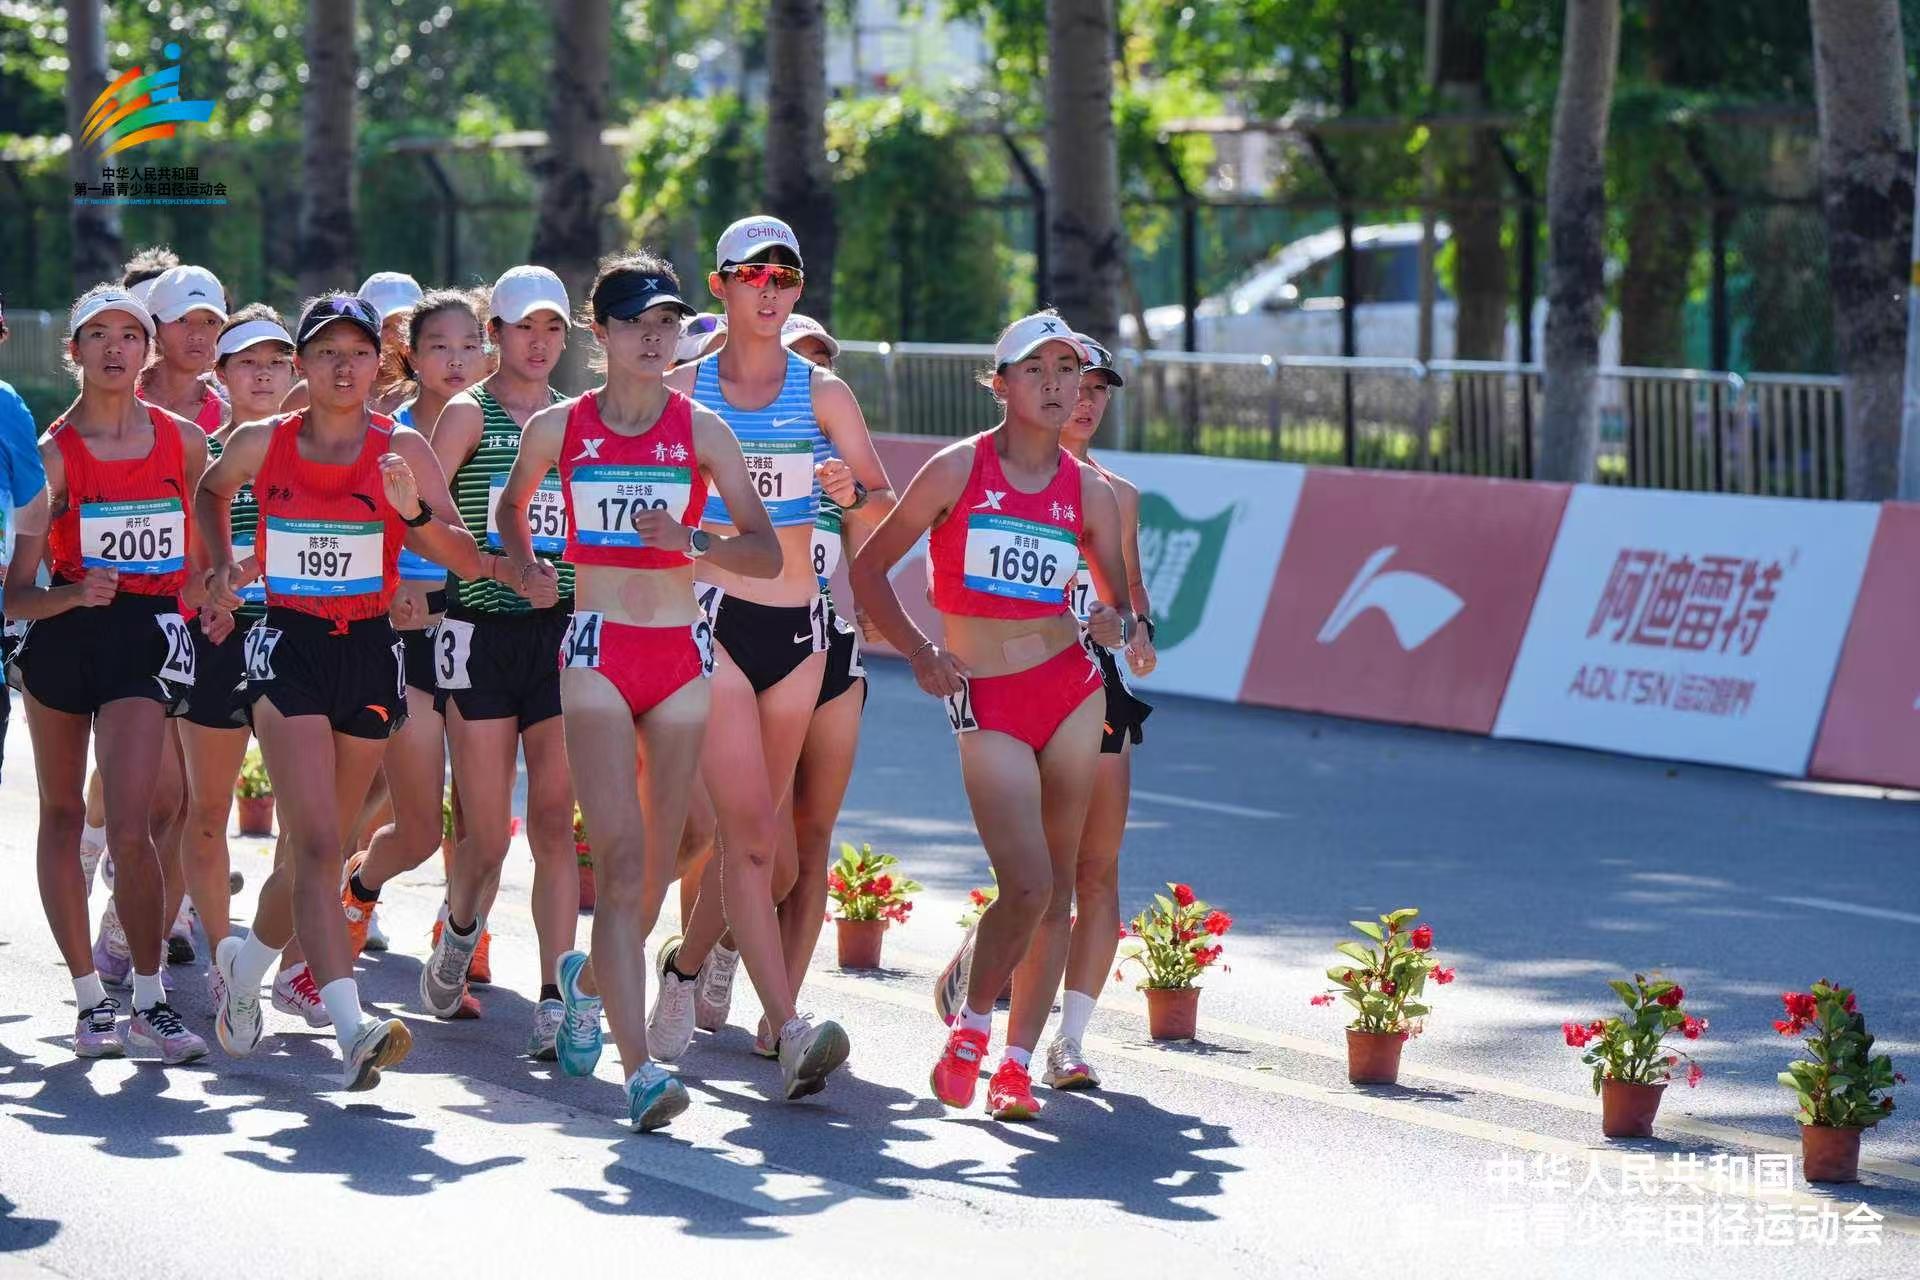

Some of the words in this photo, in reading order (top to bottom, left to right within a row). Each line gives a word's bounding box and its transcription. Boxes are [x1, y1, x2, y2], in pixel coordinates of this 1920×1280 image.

[747, 228, 788, 240] CHINA
[651, 441, 688, 462] 青海
[1049, 501, 1076, 522] 青海
[100, 528, 172, 561] 2005
[309, 537, 339, 549] 陈梦乐
[297, 550, 352, 577] 1997
[990, 545, 1058, 587] 1696
[1585, 548, 1783, 656] 阿迪雷特
[166, 623, 194, 675] 29
[440, 630, 456, 680] 3
[564, 614, 598, 668] 34
